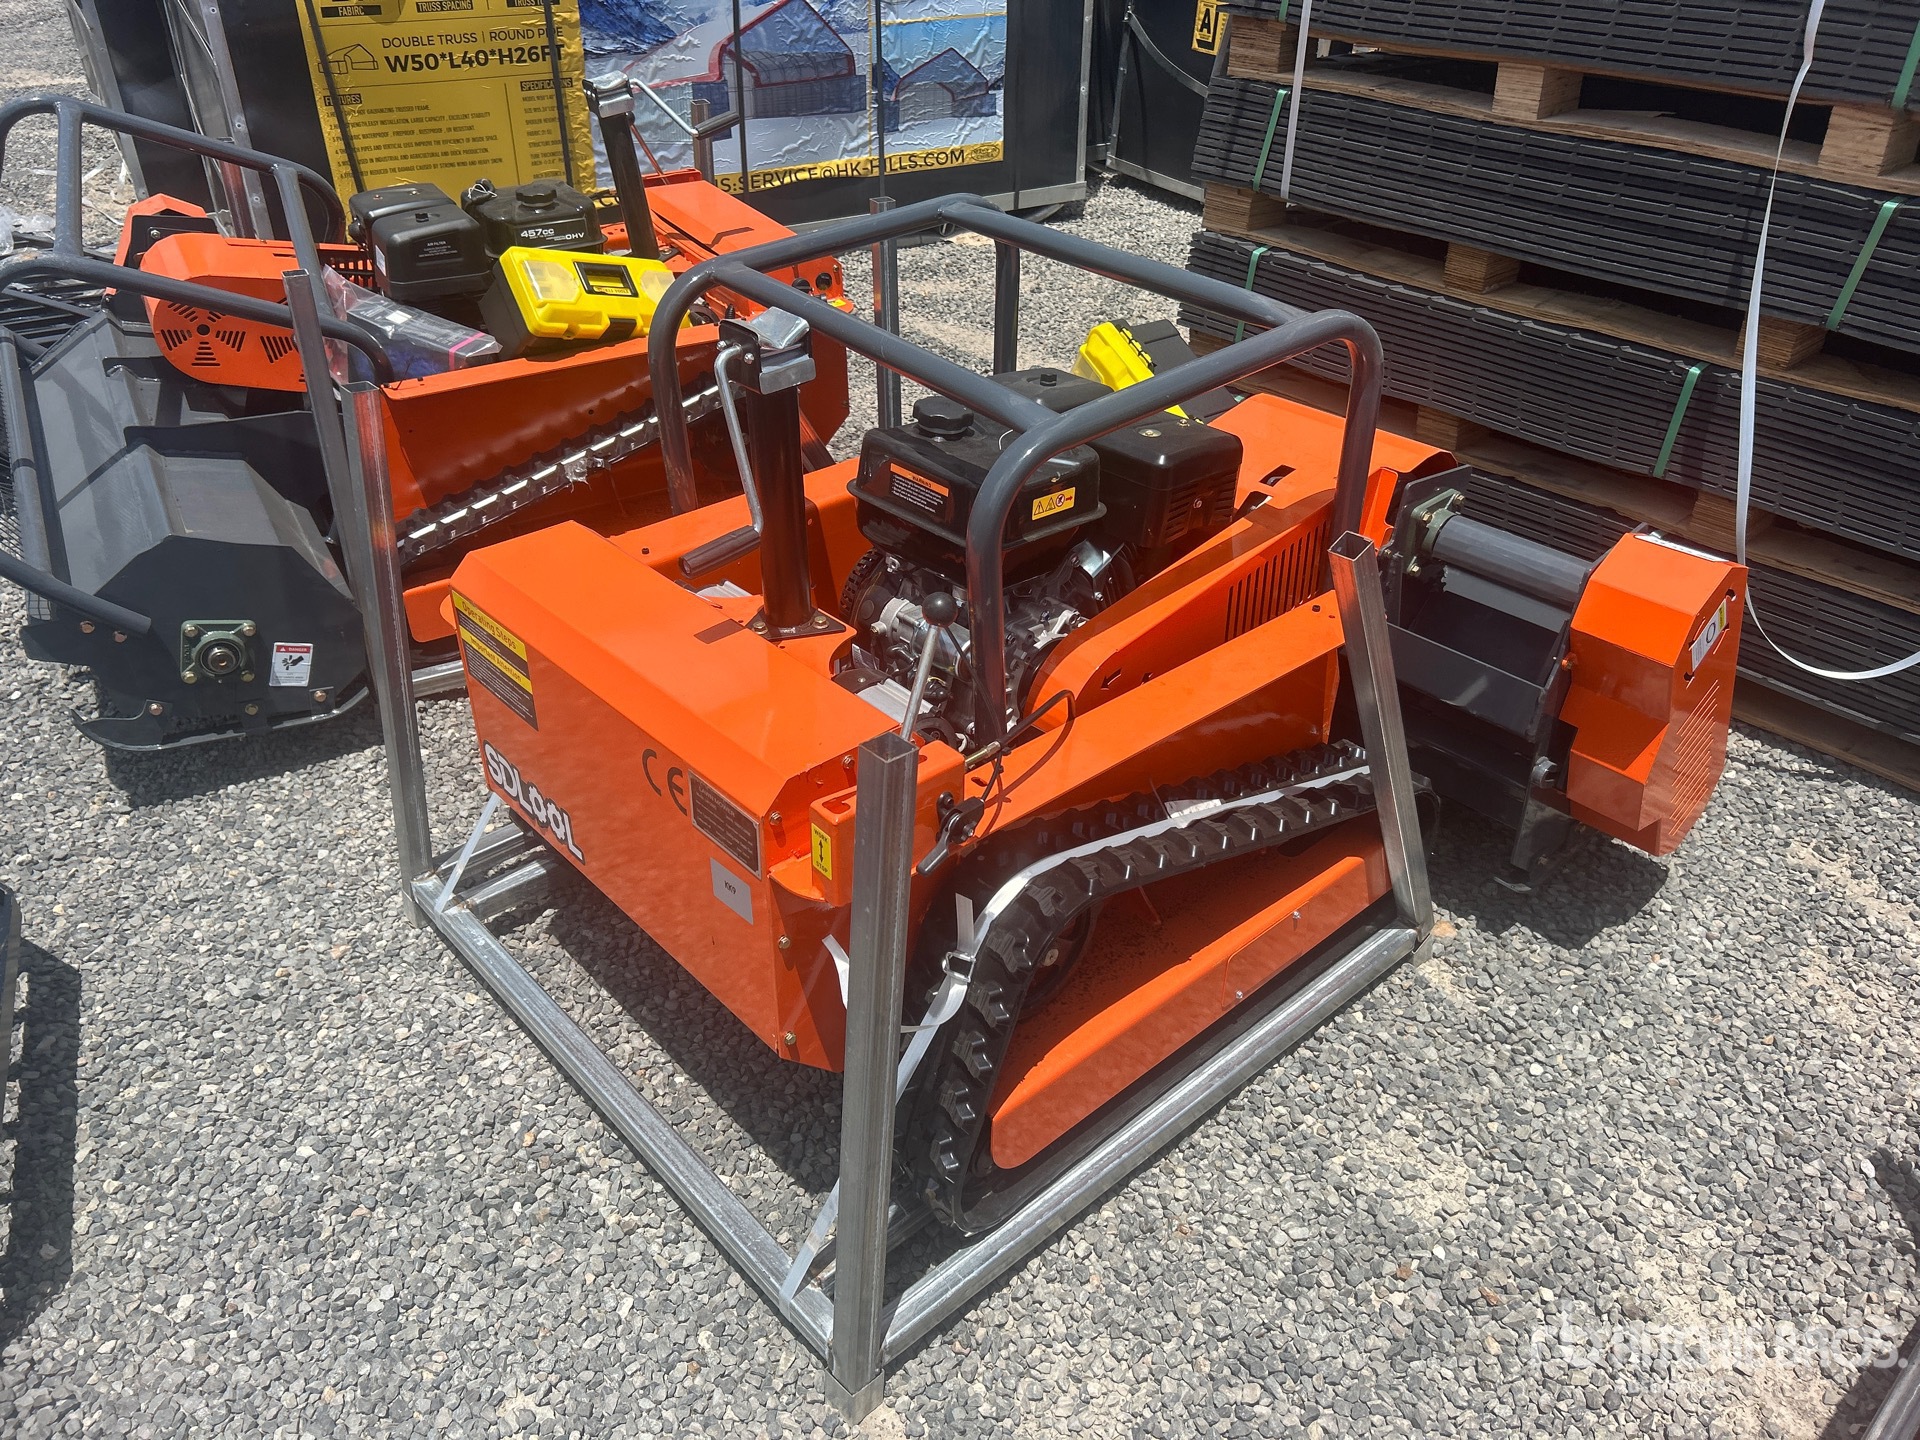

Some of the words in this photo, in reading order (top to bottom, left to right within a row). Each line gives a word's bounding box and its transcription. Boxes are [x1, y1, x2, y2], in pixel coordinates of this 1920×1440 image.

[338, 6, 365, 16] FABIRC
[418, 2, 441, 12] TRUSS
[442, 0, 472, 11] SPACING
[1200, 8, 1211, 34] A
[381, 35, 435, 49] DOUBLE
[437, 32, 478, 45] TRUSS
[489, 29, 535, 42] ROUND
[565, 232, 585, 240] OHV
[461, 600, 495, 636] Operating
[495, 624, 516, 650] Steps
[814, 828, 828, 842] WORK
[816, 860, 829, 873] STOP
